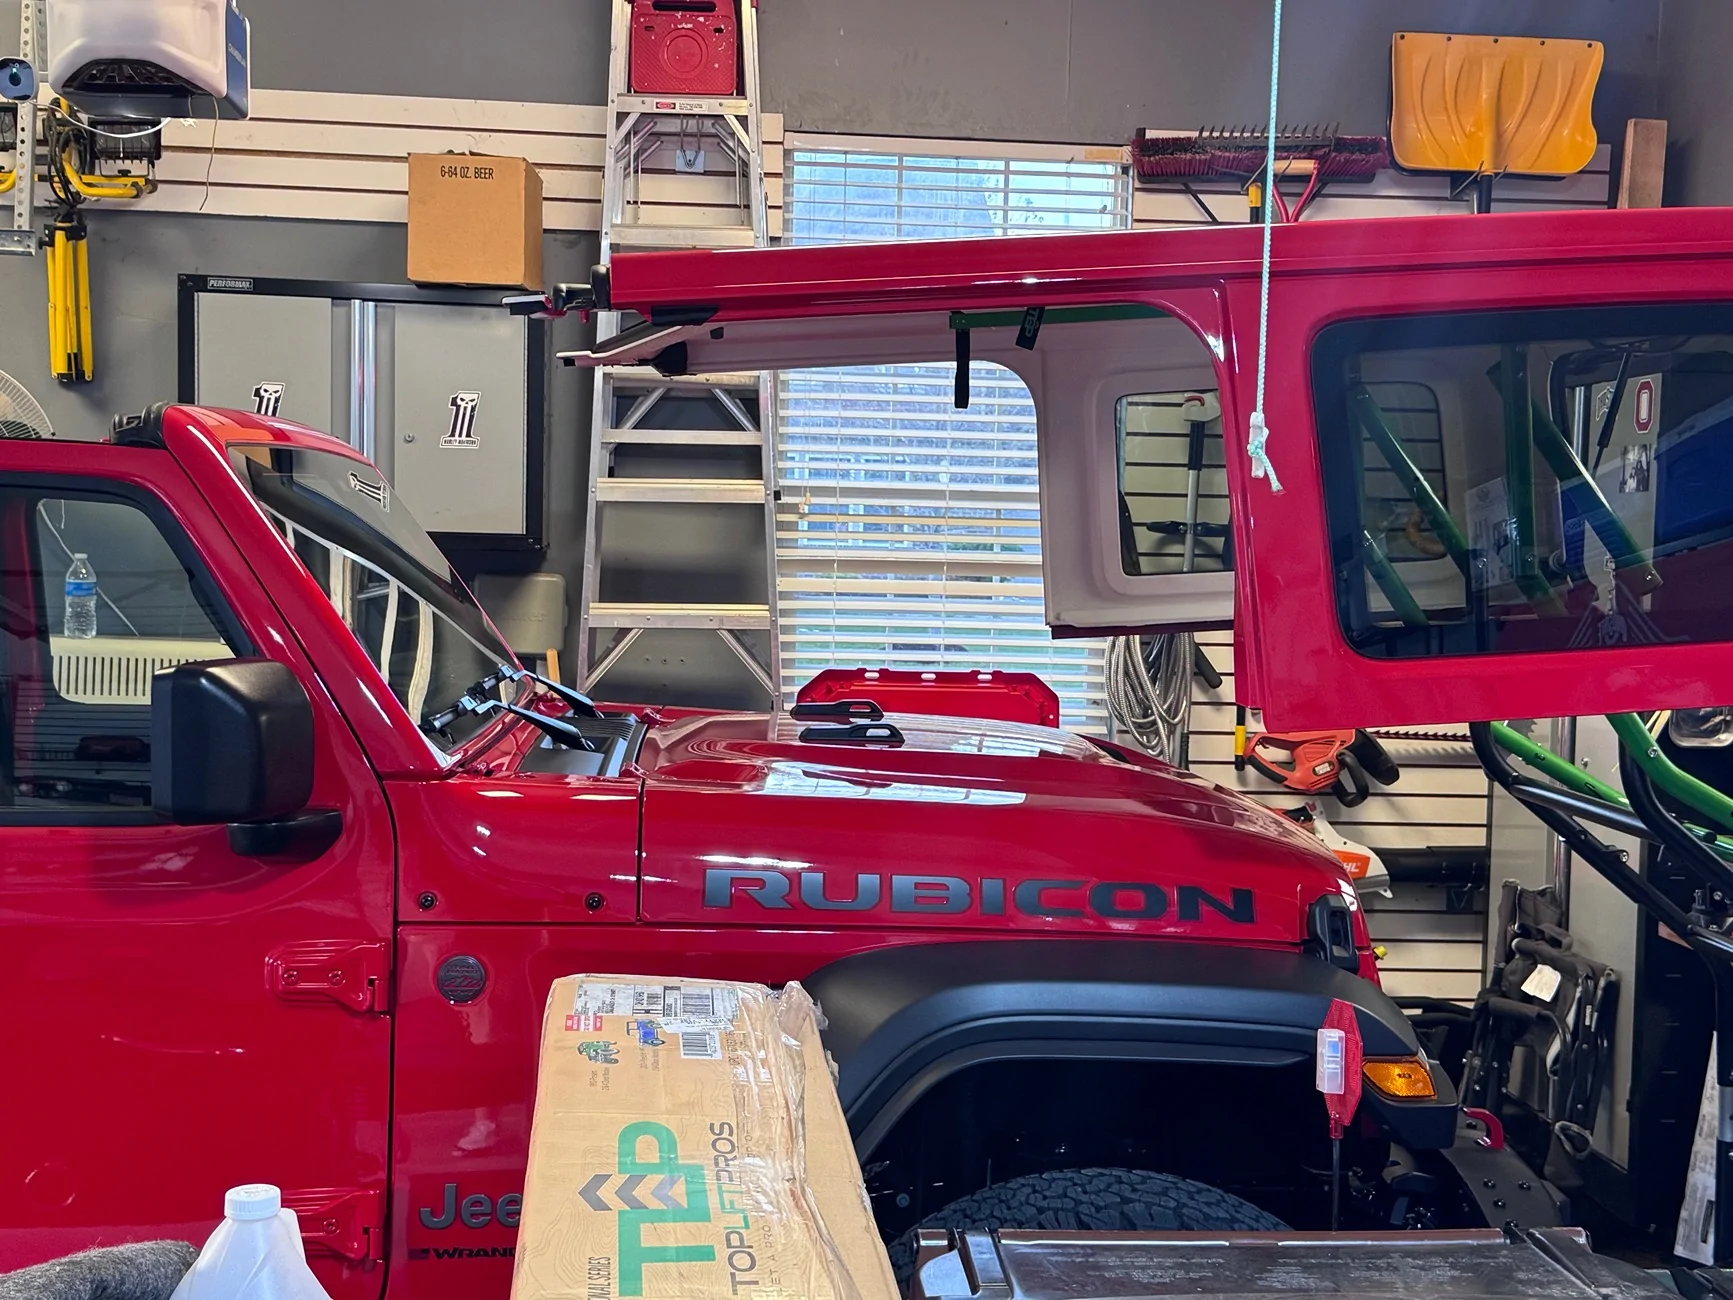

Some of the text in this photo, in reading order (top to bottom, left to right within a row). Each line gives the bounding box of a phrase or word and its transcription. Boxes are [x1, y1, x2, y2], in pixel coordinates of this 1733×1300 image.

[440, 165, 458, 178] 6-64
[474, 166, 494, 180] BEER
[703, 869, 1256, 924] RUBICON
[420, 1183, 523, 1229] Jee
[587, 1256, 611, 1281] SERIES
